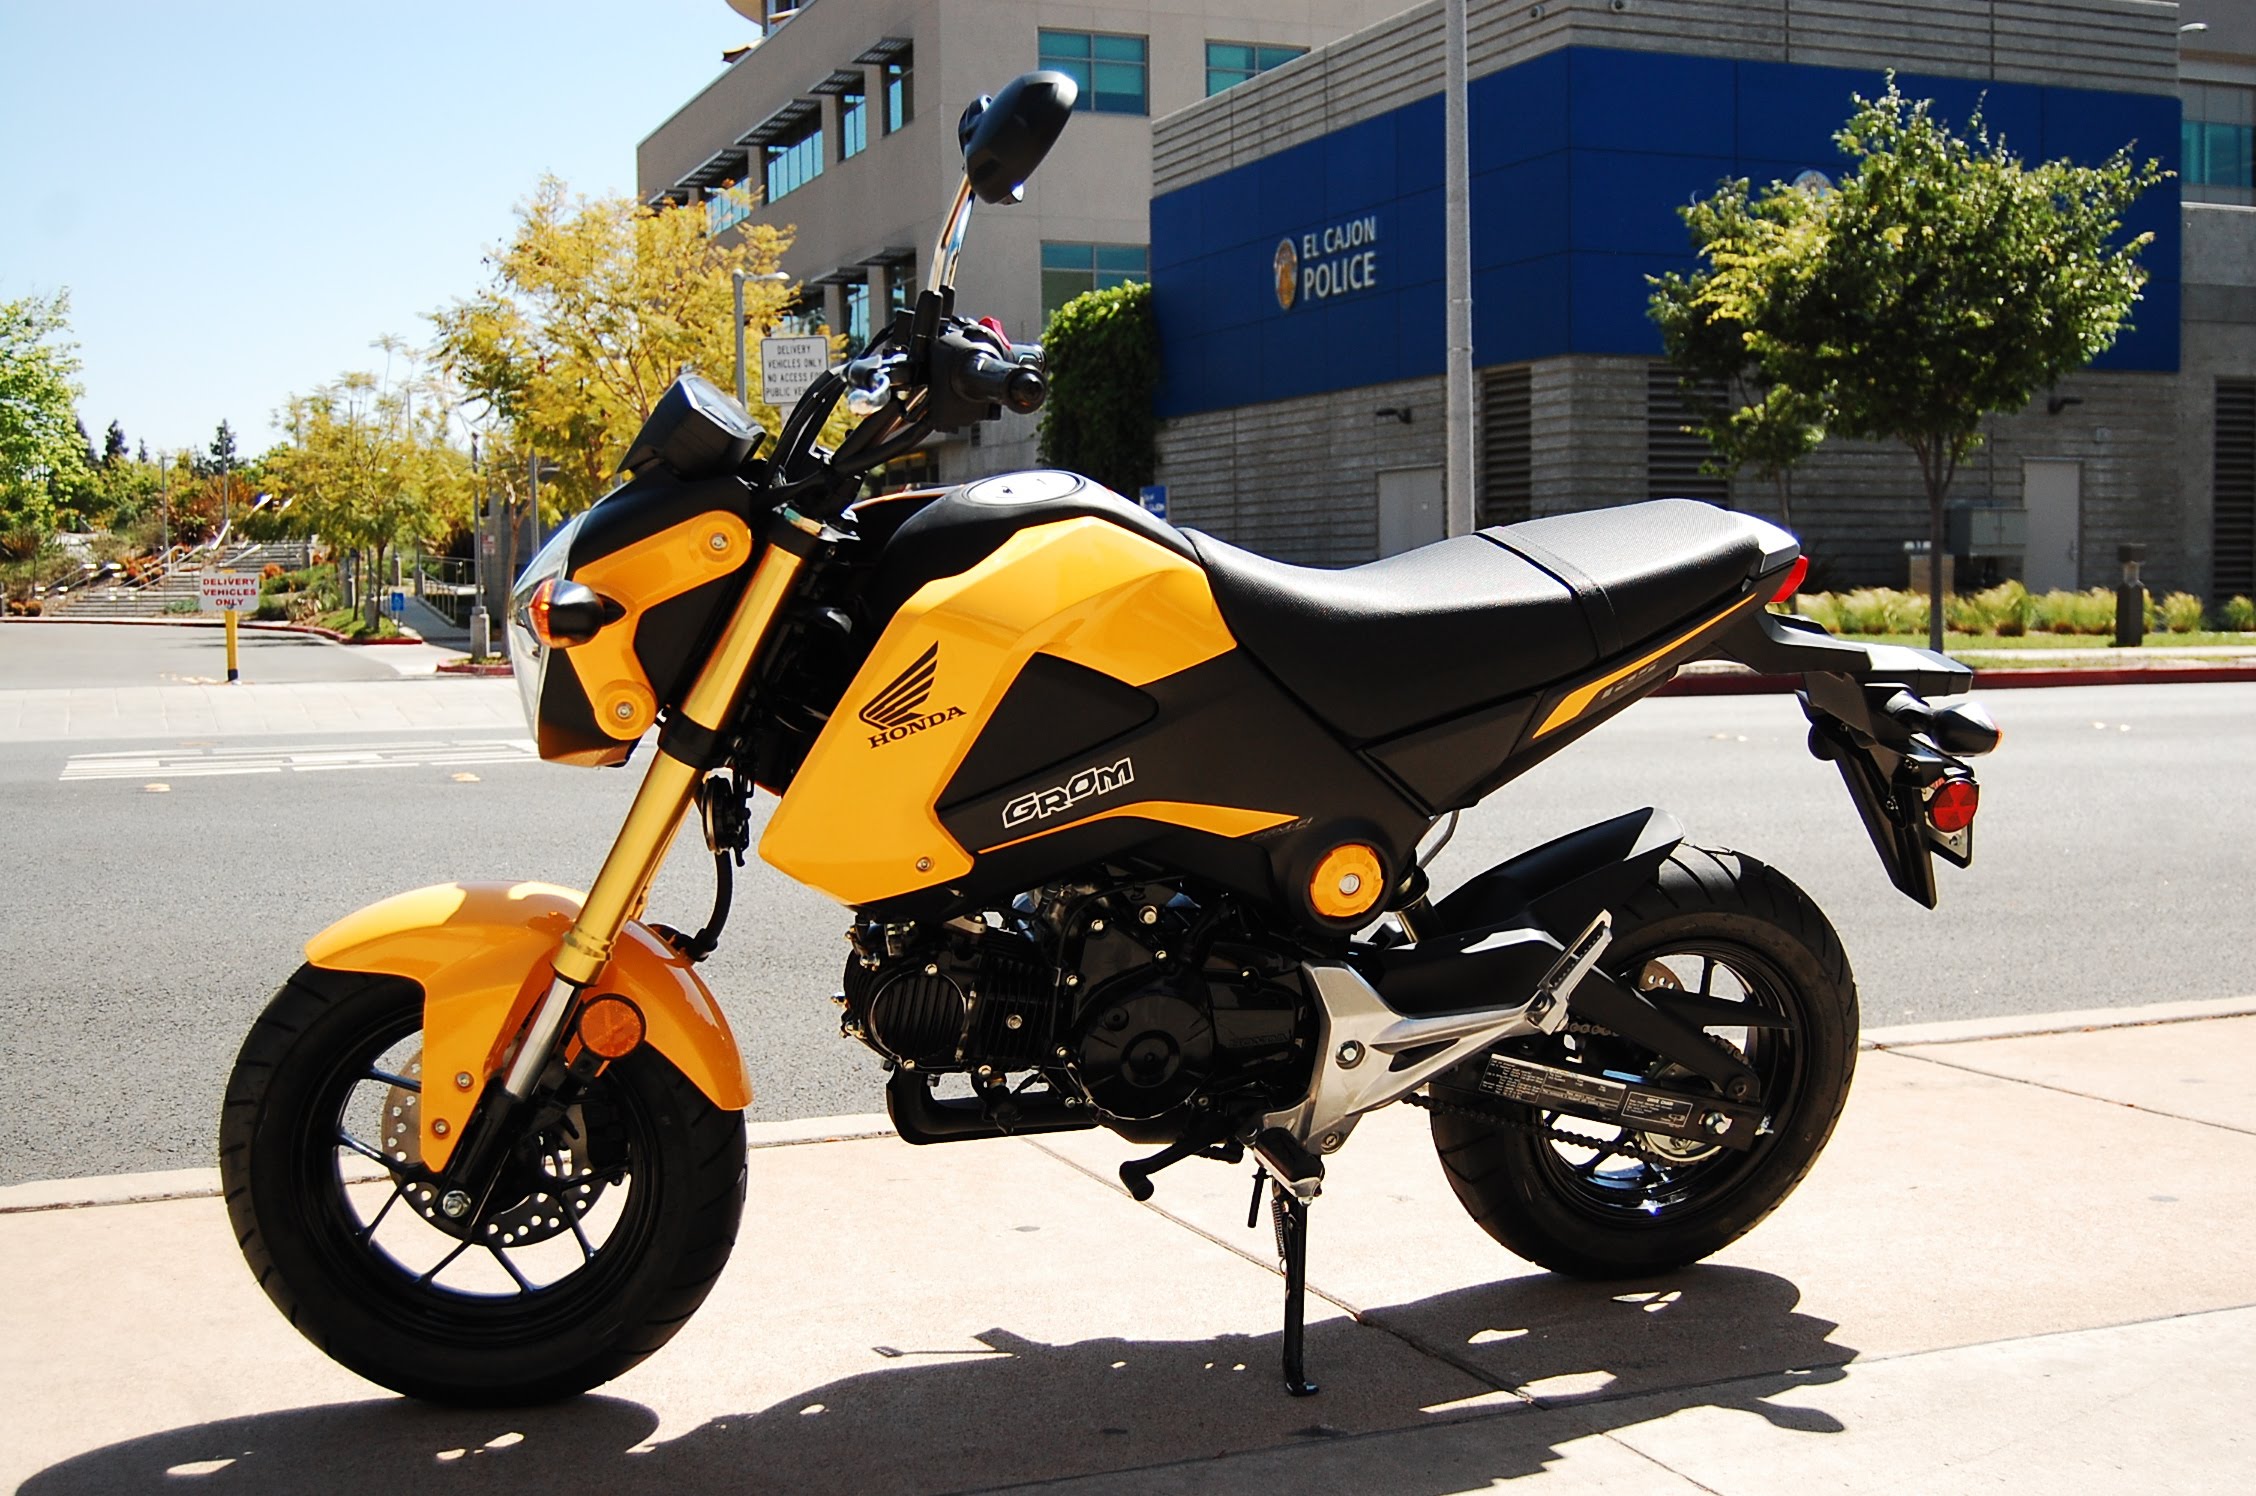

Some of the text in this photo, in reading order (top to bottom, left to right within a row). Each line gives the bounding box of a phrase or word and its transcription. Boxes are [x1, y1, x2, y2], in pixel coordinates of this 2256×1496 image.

[1303, 216, 1376, 259] EL CAJON
[1304, 251, 1376, 300] POLICE
[777, 345, 811, 355] DELIVERY
[768, 359, 822, 369] VEHICLES ONLY
[767, 373, 776, 383] NO
[780, 372, 807, 382] ACCESS
[766, 387, 790, 397] PUBLIC
[203, 578, 256, 586] DELIVERY
[203, 588, 257, 596] VEHICLES
[215, 598, 244, 607] ONLY
[867, 705, 967, 749] HONDA
[1001, 756, 1135, 829] GROM
